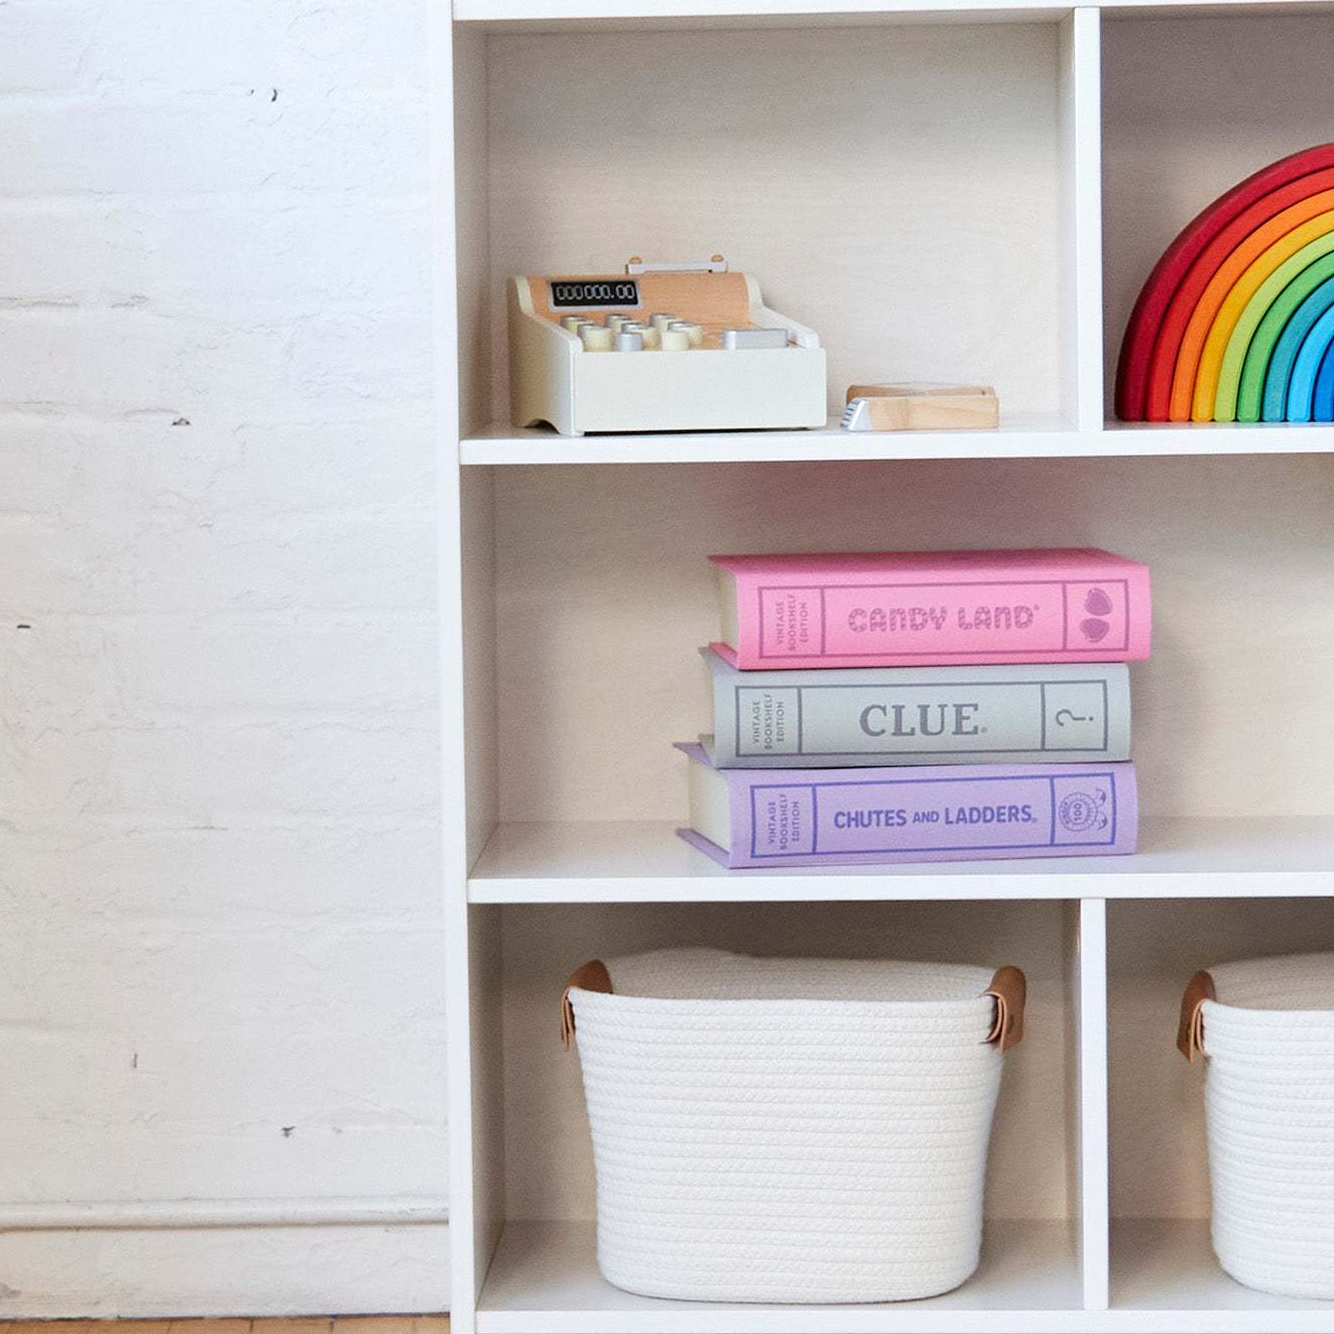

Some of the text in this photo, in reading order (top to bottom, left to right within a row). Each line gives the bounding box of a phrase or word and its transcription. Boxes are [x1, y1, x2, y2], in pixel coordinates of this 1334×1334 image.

[776, 601, 785, 645] VINTAGE
[787, 593, 796, 651] BOOKSHELF
[800, 602, 808, 643] EDITION
[848, 606, 947, 633] CANDY
[752, 700, 761, 745] VINTAGE
[764, 693, 774, 750] BOOKSHELF
[777, 700, 785, 743] EDITION
[768, 800, 776, 845] VINTAGE
[779, 792, 788, 850] BOOKSHELF
[791, 801, 800, 842] EDITION
[833, 809, 907, 829] CHUTES
[912, 811, 940, 824] AND
[1073, 802, 1083, 821] 100
